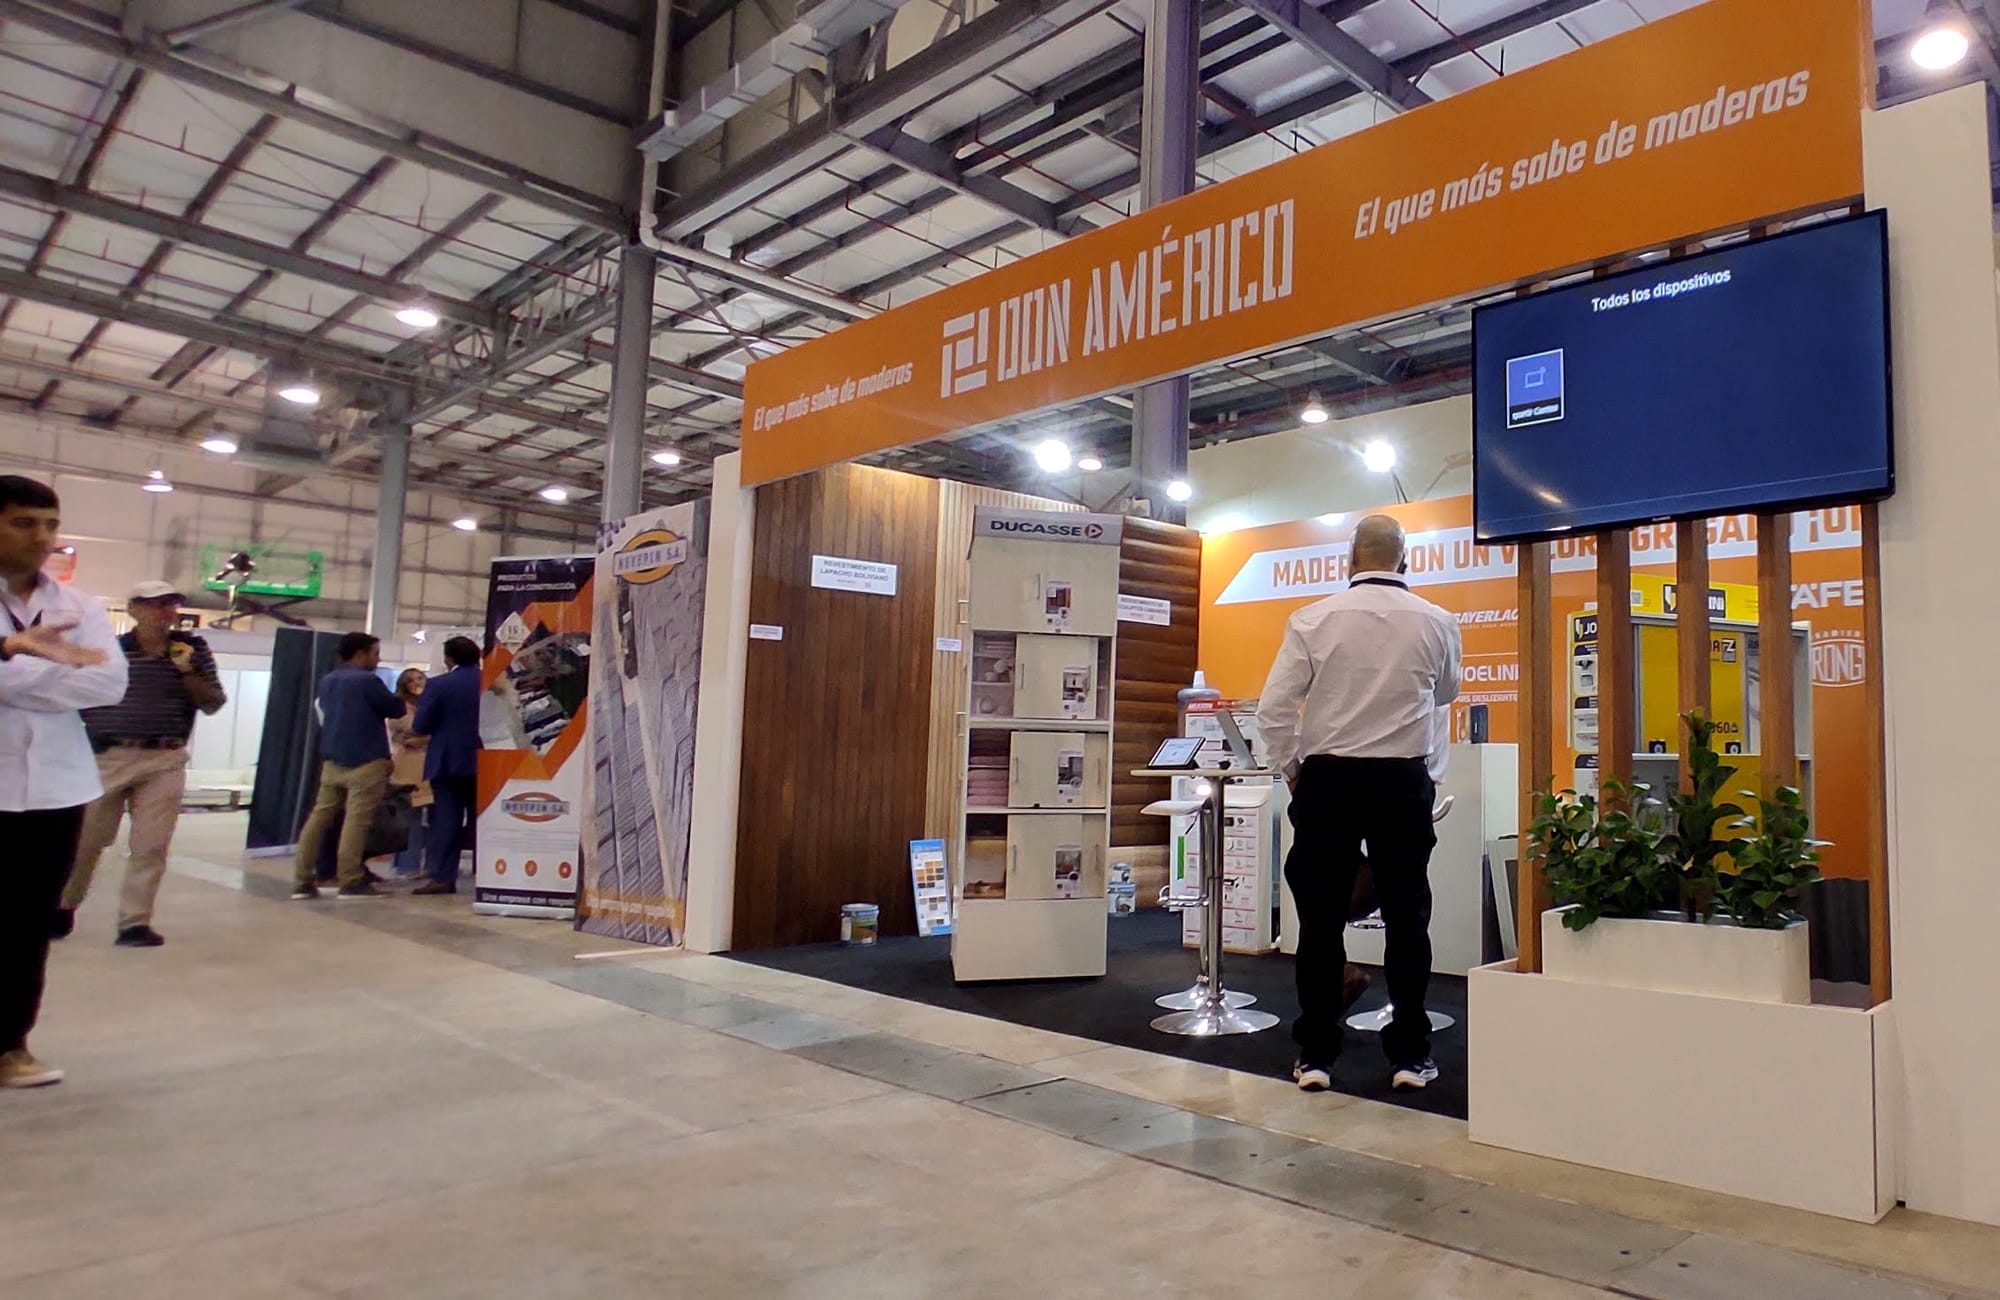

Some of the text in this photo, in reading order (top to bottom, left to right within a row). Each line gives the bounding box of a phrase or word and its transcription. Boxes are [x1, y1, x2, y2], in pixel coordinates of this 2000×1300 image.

[1354, 70, 1810, 240] El que más sabe de maderas
[998, 199, 1294, 382] DON AMÉRICO
[1591, 269, 1732, 312] Todos los dispositivos
[753, 406, 765, 431] El
[765, 405, 785, 431] que
[810, 384, 839, 412] sabe
[839, 376, 856, 403] de
[857, 362, 913, 398] maderas
[990, 520, 1082, 536] DUCASSE
[1404, 543, 1445, 574] ON
[1454, 539, 1491, 570] UN
